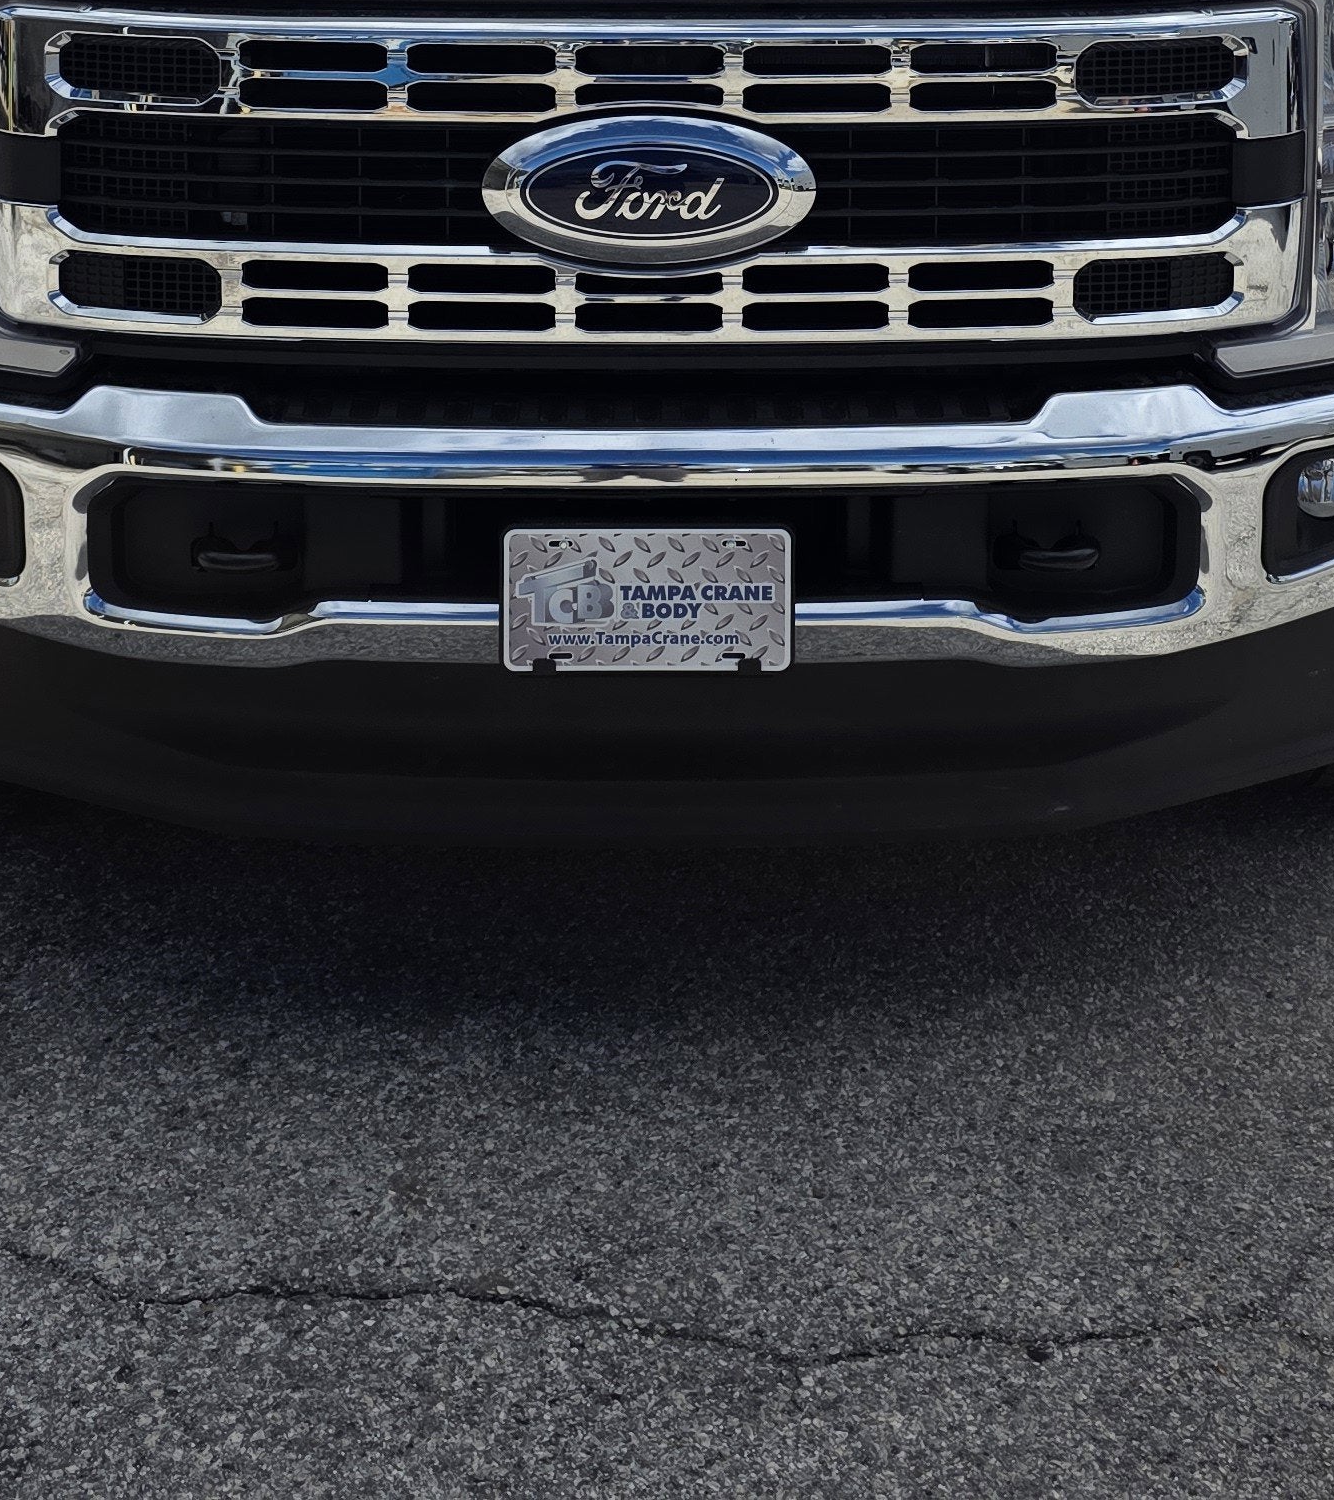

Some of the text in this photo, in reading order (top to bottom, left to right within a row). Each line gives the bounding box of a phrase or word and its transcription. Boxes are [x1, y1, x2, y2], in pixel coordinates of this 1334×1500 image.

[574, 160, 725, 221] Ford
[619, 585, 773, 601] TAMPA CRANE
[620, 602, 702, 619] & BODY
[548, 631, 740, 647] www.TampaCrane.com
